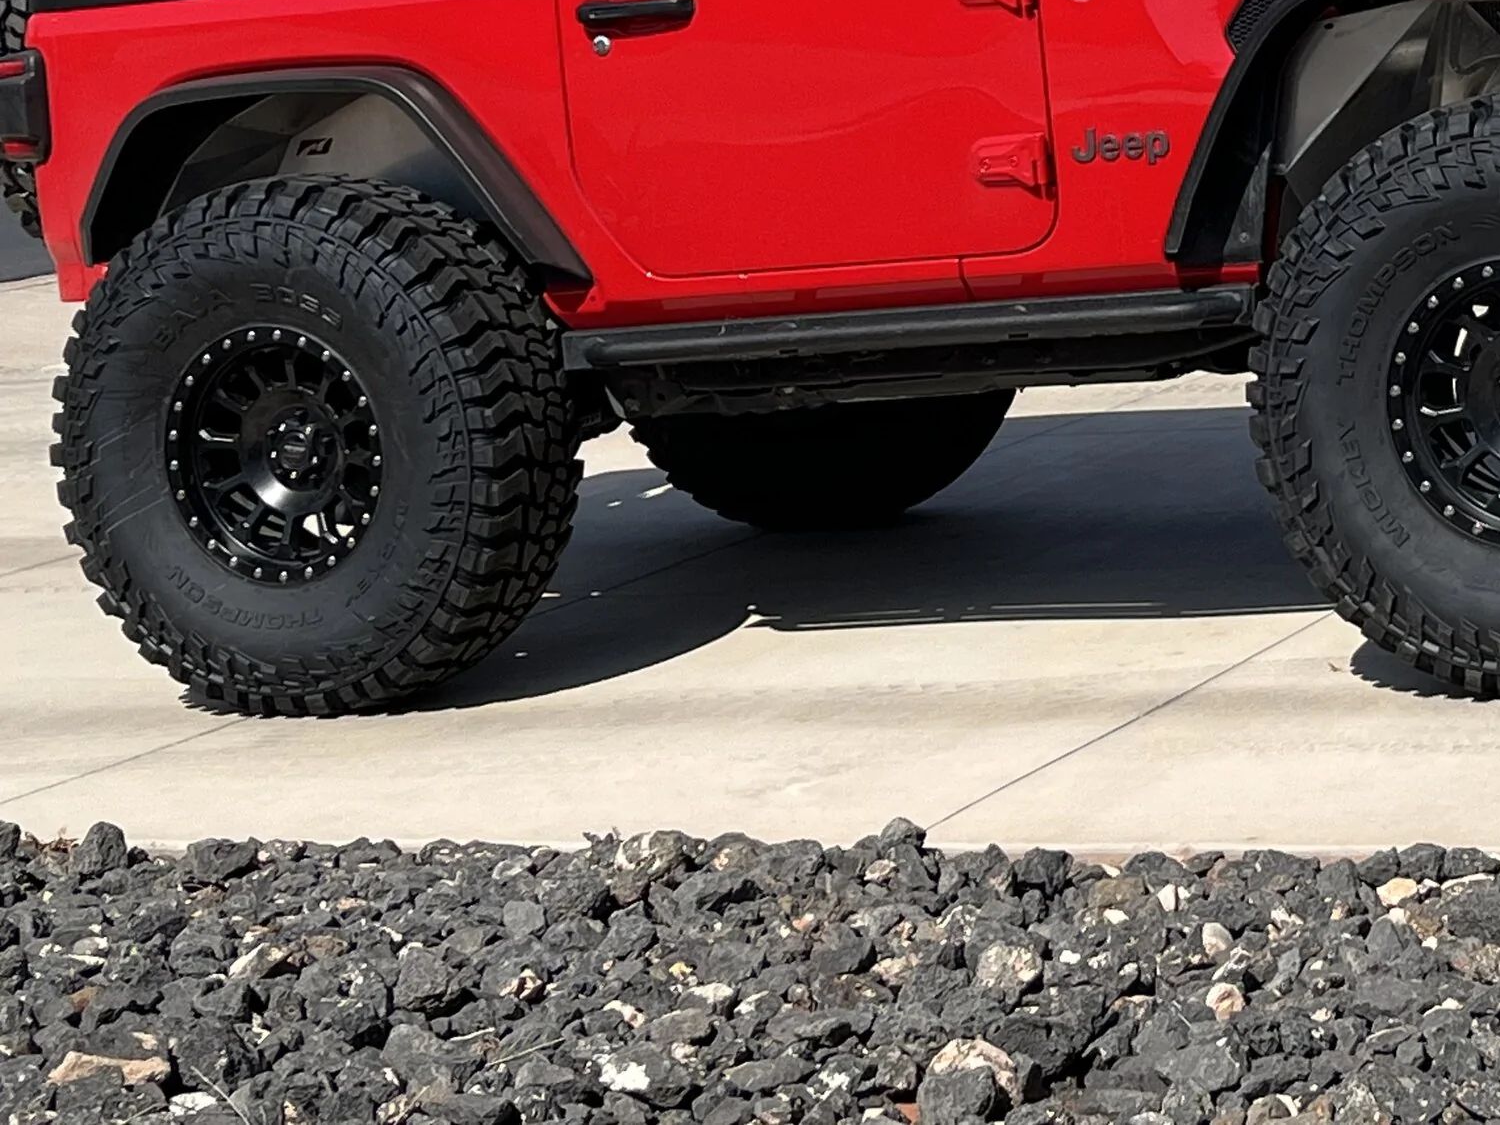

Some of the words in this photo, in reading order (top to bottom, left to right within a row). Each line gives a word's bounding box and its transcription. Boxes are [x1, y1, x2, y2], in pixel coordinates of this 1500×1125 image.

[1073, 127, 1170, 166] Jeep
[1336, 220, 1462, 386] THOMPSON
[1337, 420, 1411, 549] MICKEY
[166, 566, 324, 631] THOMPSON
